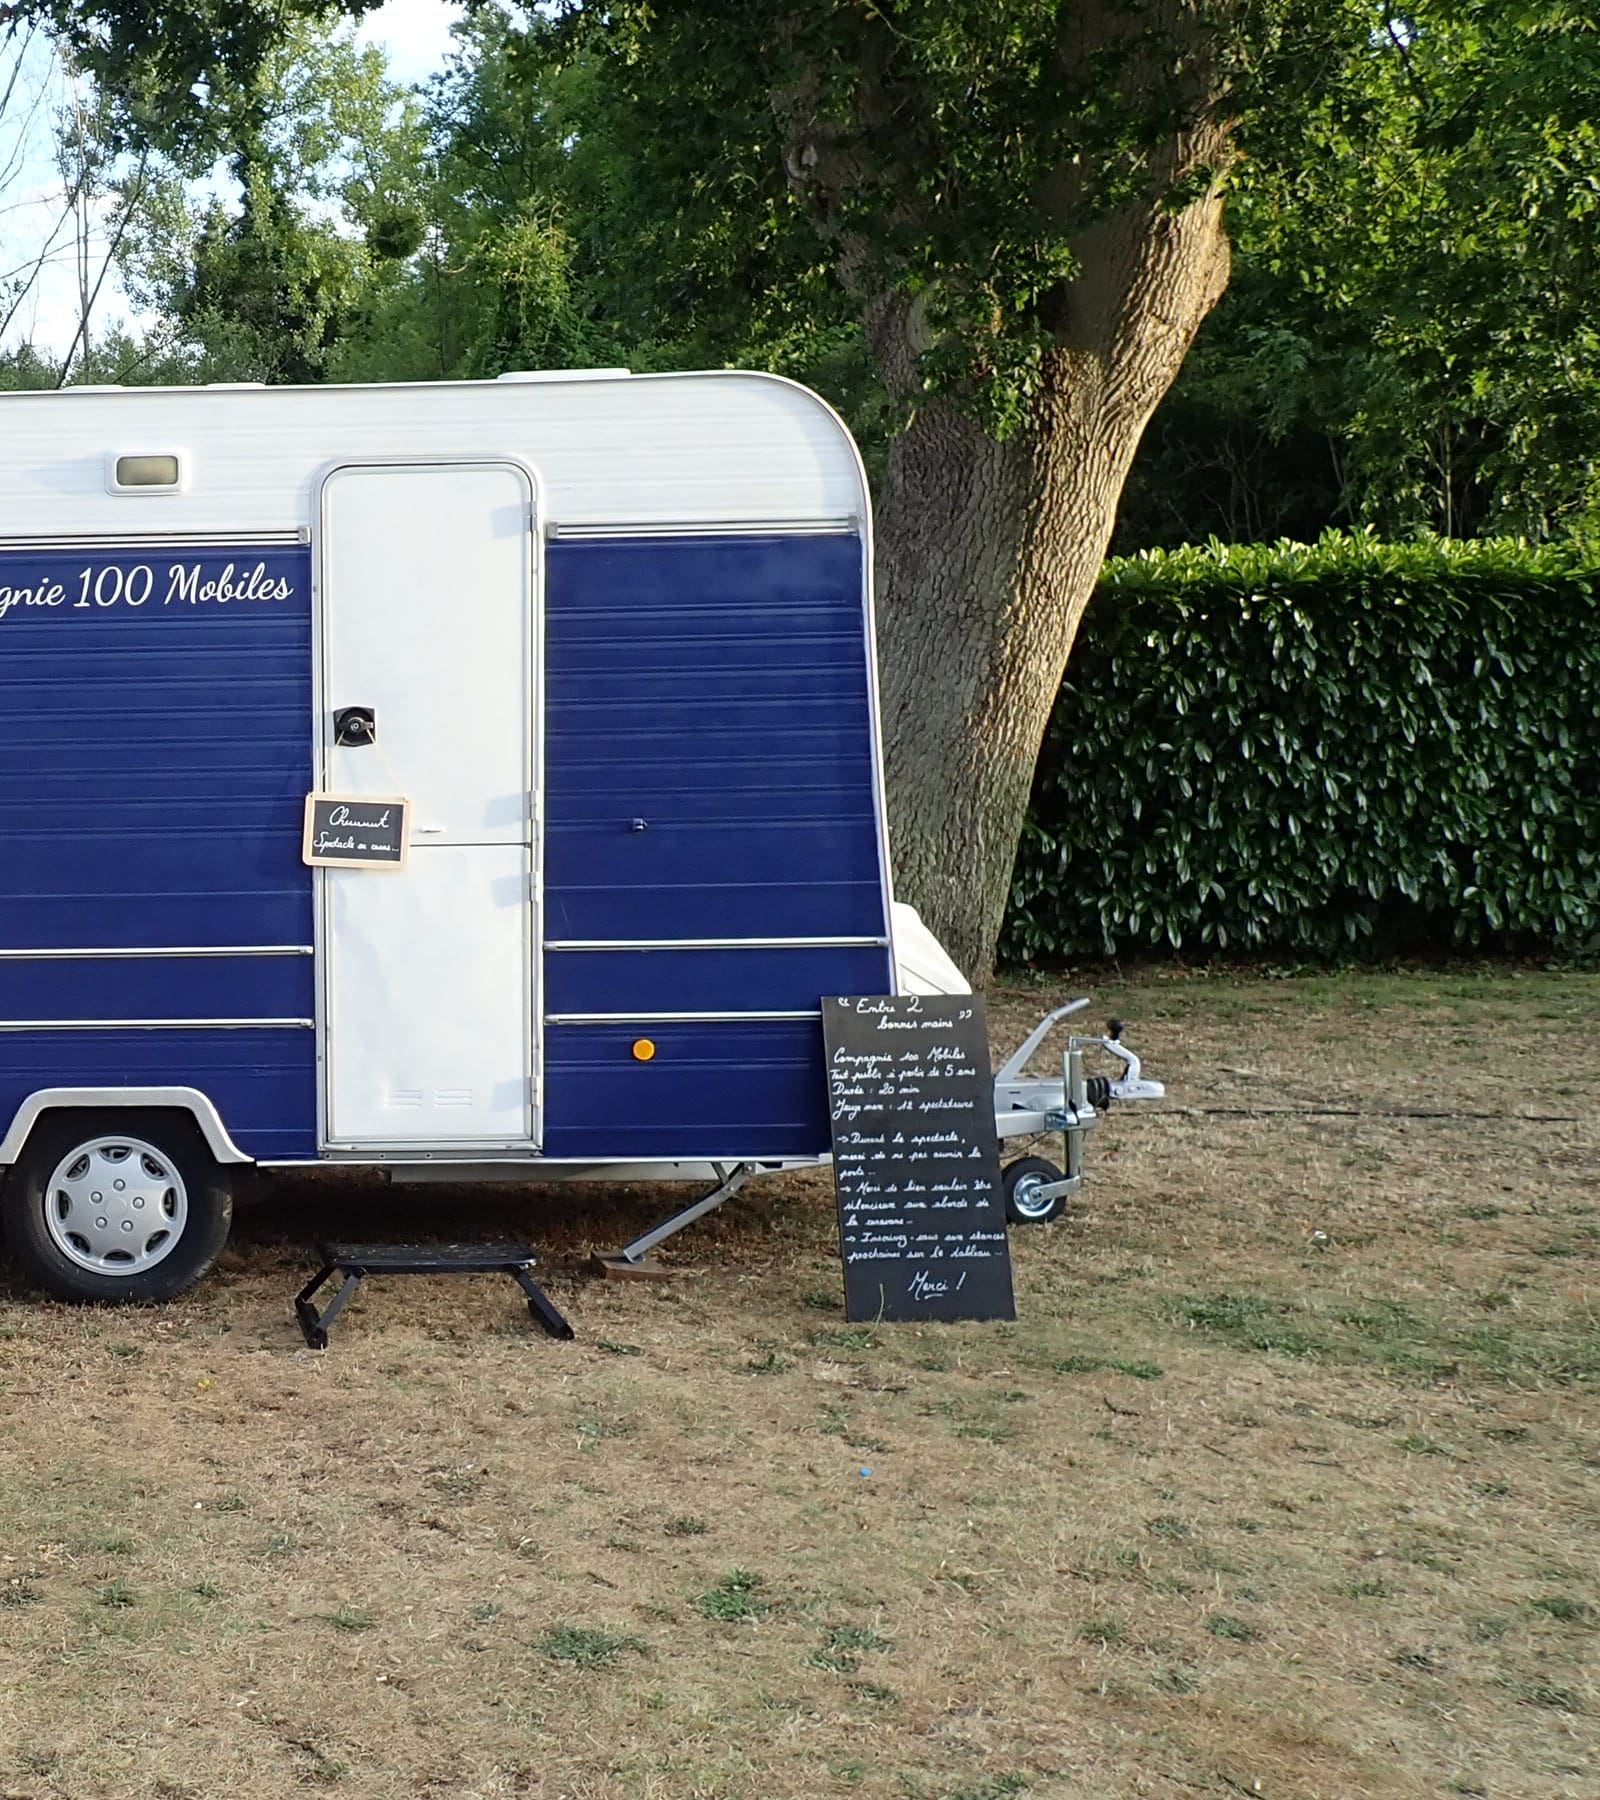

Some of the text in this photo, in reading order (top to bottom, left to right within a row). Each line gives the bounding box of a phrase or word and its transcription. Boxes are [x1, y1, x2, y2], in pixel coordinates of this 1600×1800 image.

[73, 565, 154, 609] 100
[164, 561, 295, 605] Mobiles
[856, 998, 896, 1014] Entre
[906, 996, 924, 1013] 2
[877, 1015, 918, 1030] bonnes
[921, 1017, 954, 1029] mains
[834, 1046, 966, 1068] Compagnie 100 Mobiles
[829, 1068, 849, 1080] Tout
[886, 1069, 896, 1079] à
[927, 1065, 940, 1078] de
[945, 1064, 954, 1077] 5
[956, 1067, 976, 1077] ans
[832, 1081, 865, 1096] Durée
[878, 1082, 895, 1095] 20
[899, 1084, 921, 1095] min
[832, 1098, 861, 1121] Jauge
[897, 1100, 914, 1111] 12
[919, 1098, 975, 1114] spectateurs
[850, 1131, 886, 1144] Durant
[838, 1152, 866, 1161] merci
[909, 1151, 928, 1163] pas
[933, 1149, 963, 1159] ouvrir
[856, 1181, 881, 1195] Merci
[904, 1179, 926, 1192] bien
[931, 1177, 968, 1192] vouloir
[907, 1270, 949, 1301] Merci
